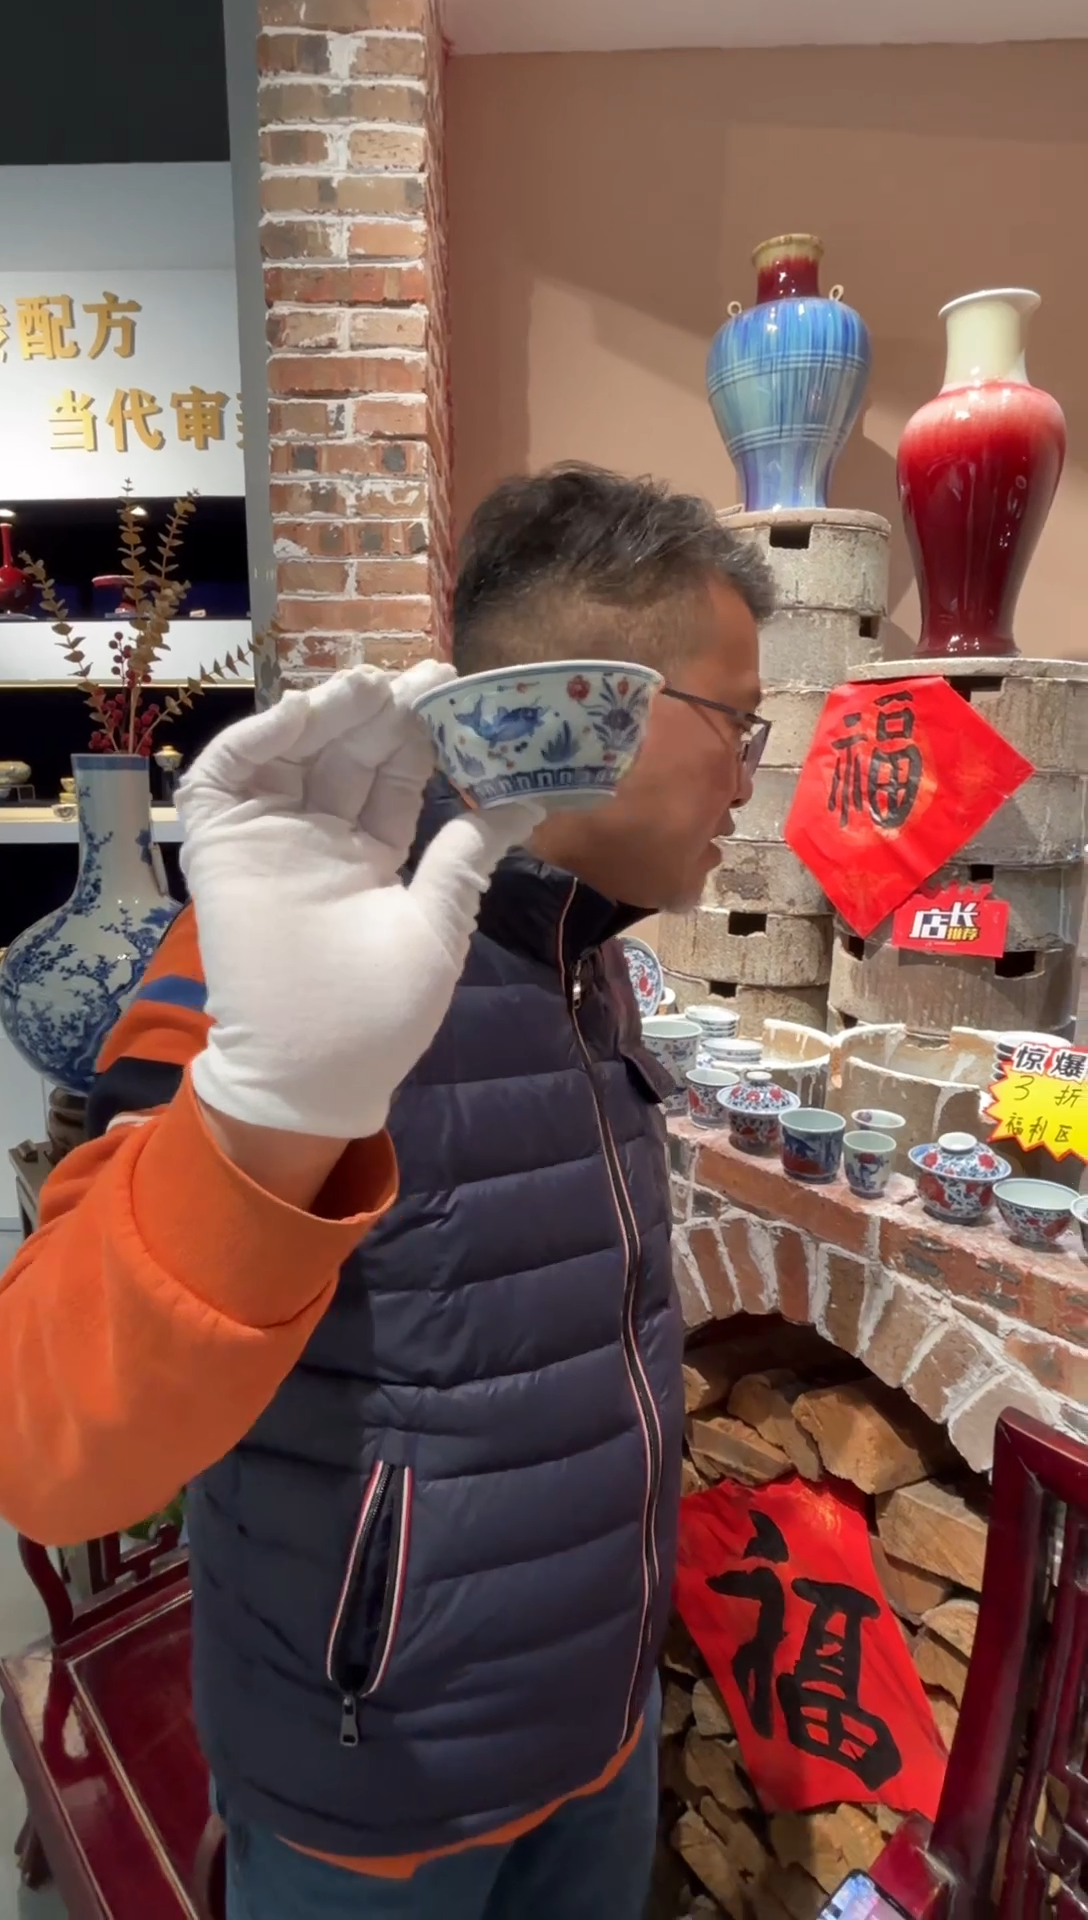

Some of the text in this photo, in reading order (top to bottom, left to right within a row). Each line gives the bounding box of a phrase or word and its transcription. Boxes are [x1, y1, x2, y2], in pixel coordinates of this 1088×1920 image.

[0, 291, 142, 362] 配方
[49, 386, 244, 452] 当代审
[828, 690, 922, 829] 福
[908, 901, 979, 940] 店长
[1014, 1046, 1087, 1078] 惊爆
[1005, 1112, 1073, 1143] 福利区
[705, 1509, 902, 1791] 福
